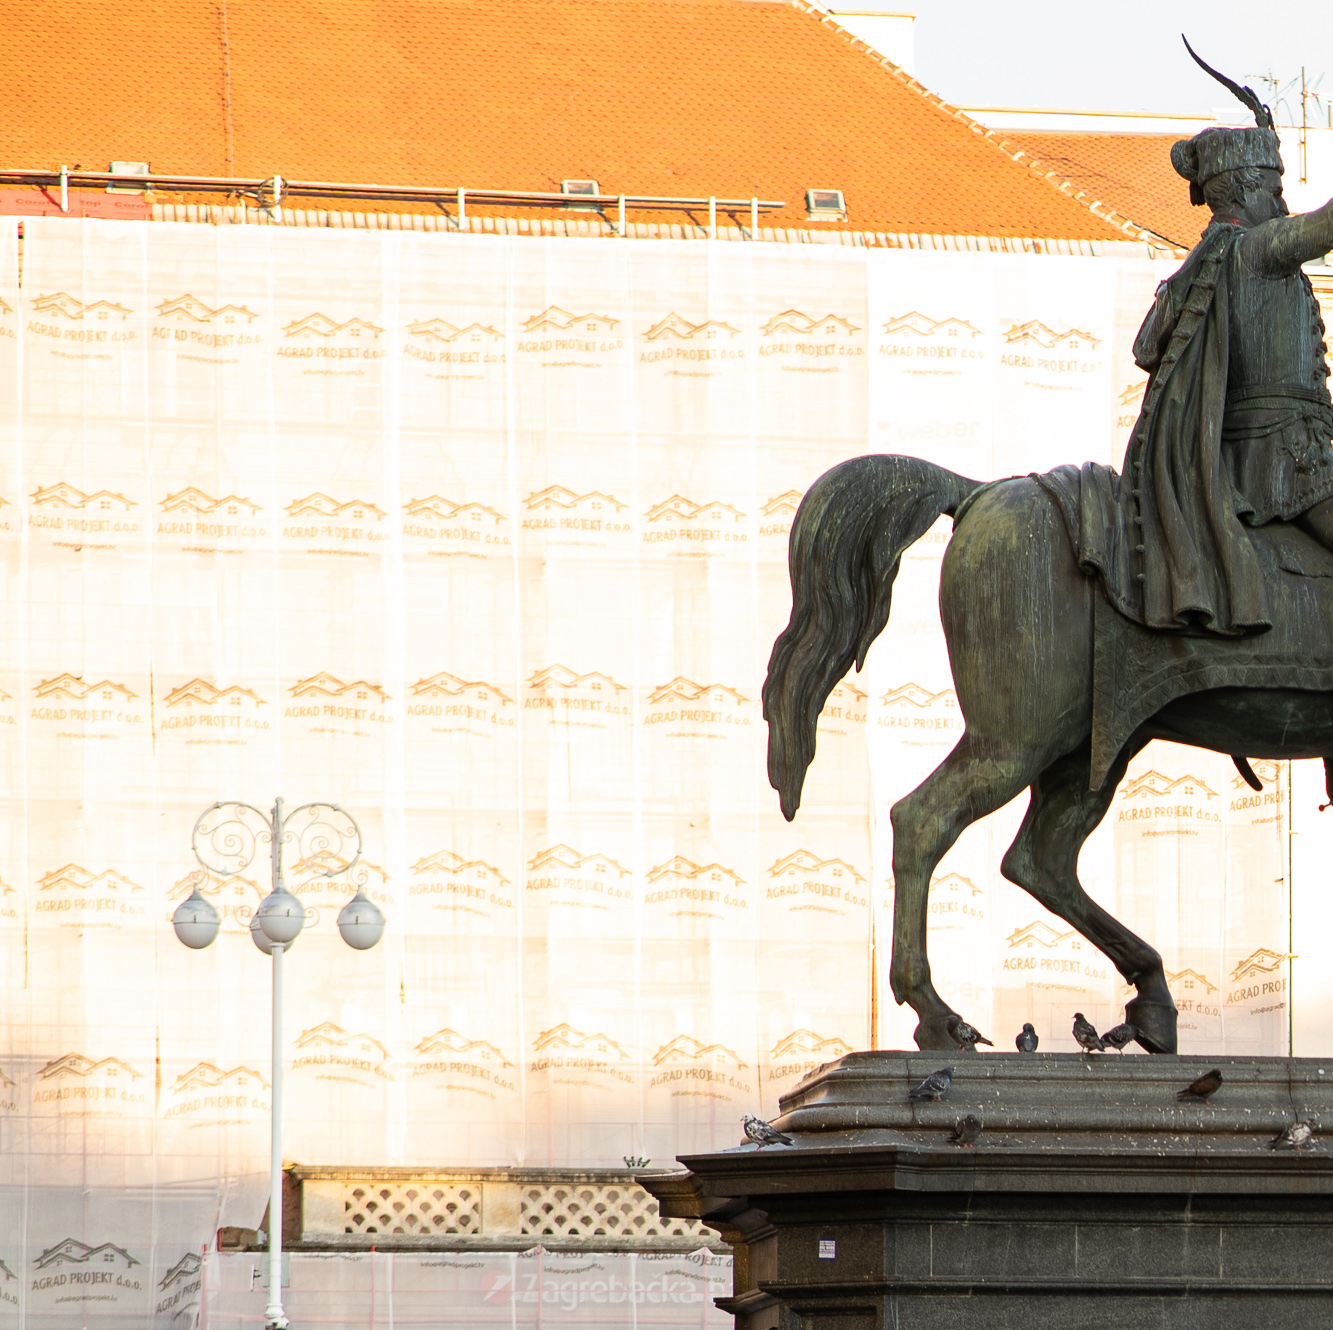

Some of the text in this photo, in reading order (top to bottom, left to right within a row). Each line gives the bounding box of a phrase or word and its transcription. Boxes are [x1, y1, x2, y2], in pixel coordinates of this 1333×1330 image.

[27, 320, 58, 339] AGRAD
[62, 329, 108, 342] PROJEKT
[277, 347, 360, 361] AGRAD PROJEKT
[402, 344, 480, 363] AGRAD PROJEKT
[518, 340, 597, 353] AGRAD PROJEKT
[758, 344, 792, 358] AGRAD
[795, 343, 836, 357] PROJEKT
[879, 344, 957, 359] AGRAD PROJEKT
[640, 348, 673, 363] AGRAD
[676, 348, 717, 363] PROJEKT
[1000, 354, 1078, 372] AGRAD PROJEKT
[29, 515, 63, 530] AGRAD
[67, 518, 111, 533] PROJEKT
[157, 522, 238, 538] AGRAD PROJEKT
[521, 519, 556, 531] AGRAD
[560, 517, 602, 531] PROJEKT
[283, 525, 364, 541] AGRAD PROJEKT
[402, 524, 482, 543] AGRAD PROJEKT
[643, 531, 677, 544] AGRAD
[680, 530, 721, 544] PROJEKT
[524, 697, 602, 712] AGRAD PROJEKT
[31, 707, 113, 722] AGRAD PROJEKT
[285, 704, 367, 722] AGRAD PROJEKT
[407, 704, 442, 717] AGRAD
[445, 704, 487, 722] PROJEKT
[644, 711, 678, 726] AGRAD
[681, 709, 723, 724] PROJEKT
[161, 714, 242, 730] AGRAD PROJEKT
[877, 715, 911, 728] AGRAD
[1230, 794, 1261, 812] AGRAD
[1119, 806, 1152, 822] AGRAD
[1154, 806, 1194, 817] PROJEKT
[409, 883, 486, 900] AGRAD PROJEKT
[526, 877, 605, 893] AGRAD PROJEKT
[766, 883, 800, 898] AGRAD
[803, 882, 842, 898] PROJEKT
[645, 887, 721, 904] AGRAD PROJEKT
[35, 898, 117, 912] AGRAD PROJEKT
[1002, 958, 1080, 971] AGRAD PROJEKT
[1227, 986, 1259, 1004] AGRAD
[292, 1057, 326, 1070] AGRAD
[329, 1054, 371, 1072] PROJEKT
[531, 1056, 608, 1074] AGRAD PROJEKT
[412, 1063, 447, 1078] AGRAD
[450, 1063, 491, 1081] PROJEKT
[651, 1070, 682, 1088] AGRAD
[686, 1069, 725, 1084] PROJEKT
[769, 1064, 801, 1081] AGRAD
[32, 1274, 67, 1291] AGRAD
[70, 1272, 113, 1287] PROJEKT
